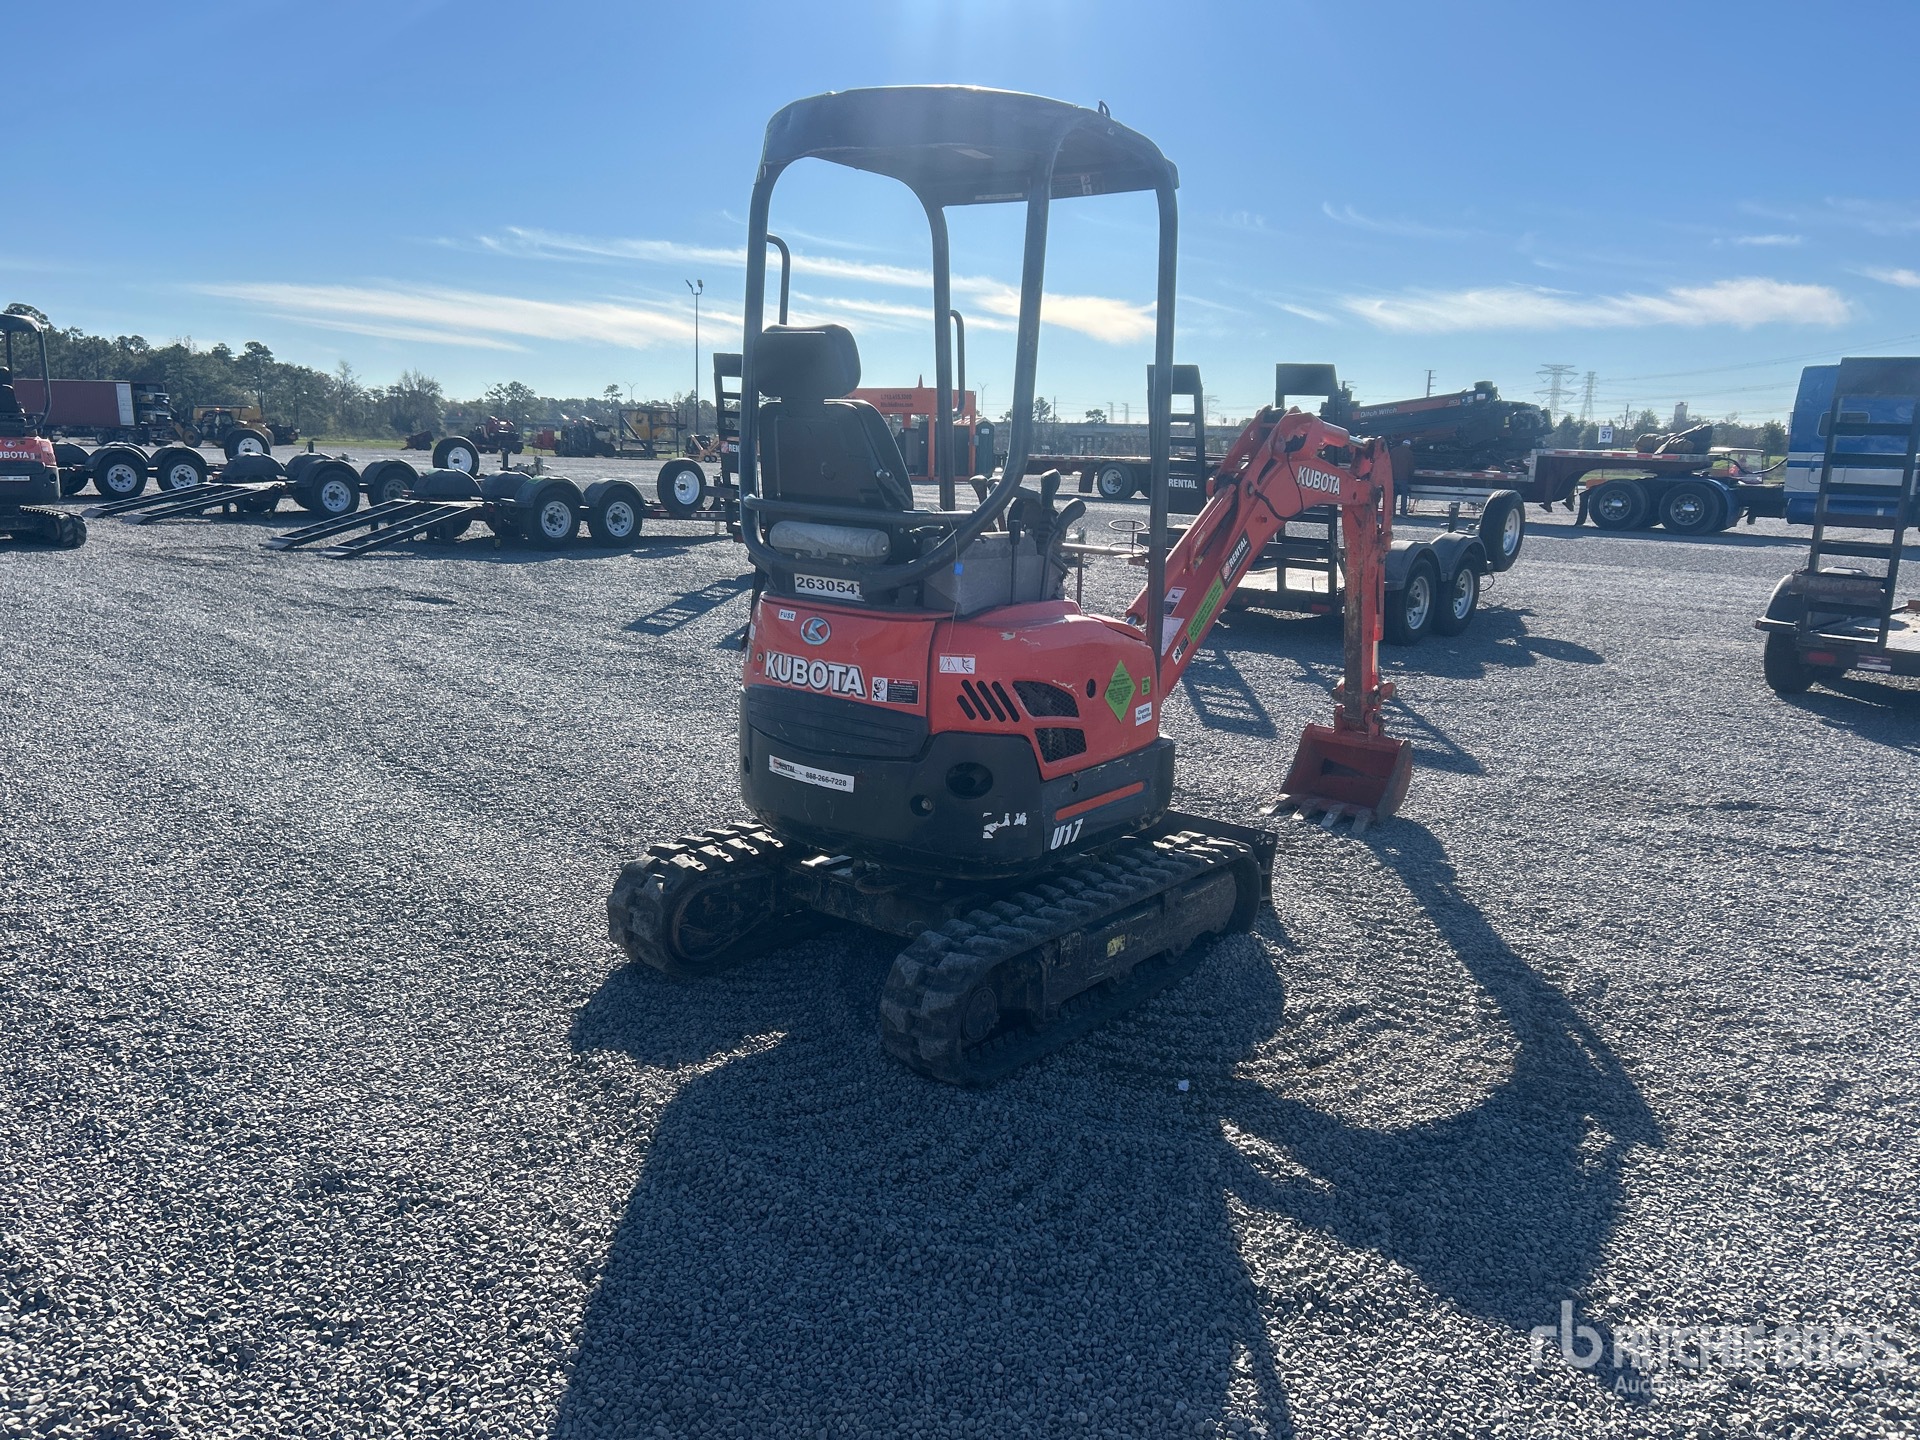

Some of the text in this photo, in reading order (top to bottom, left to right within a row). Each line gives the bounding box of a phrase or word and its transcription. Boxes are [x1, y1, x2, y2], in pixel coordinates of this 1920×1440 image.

[1360, 407, 1398, 418] Ditch Witch
[1168, 478, 1198, 489] RENTAL
[1296, 465, 1340, 496] KUBOTA
[1229, 537, 1248, 568] RENTAL
[780, 611, 795, 619] FUSE
[765, 650, 867, 698] KUBOTA
[1050, 818, 1084, 850] U17
